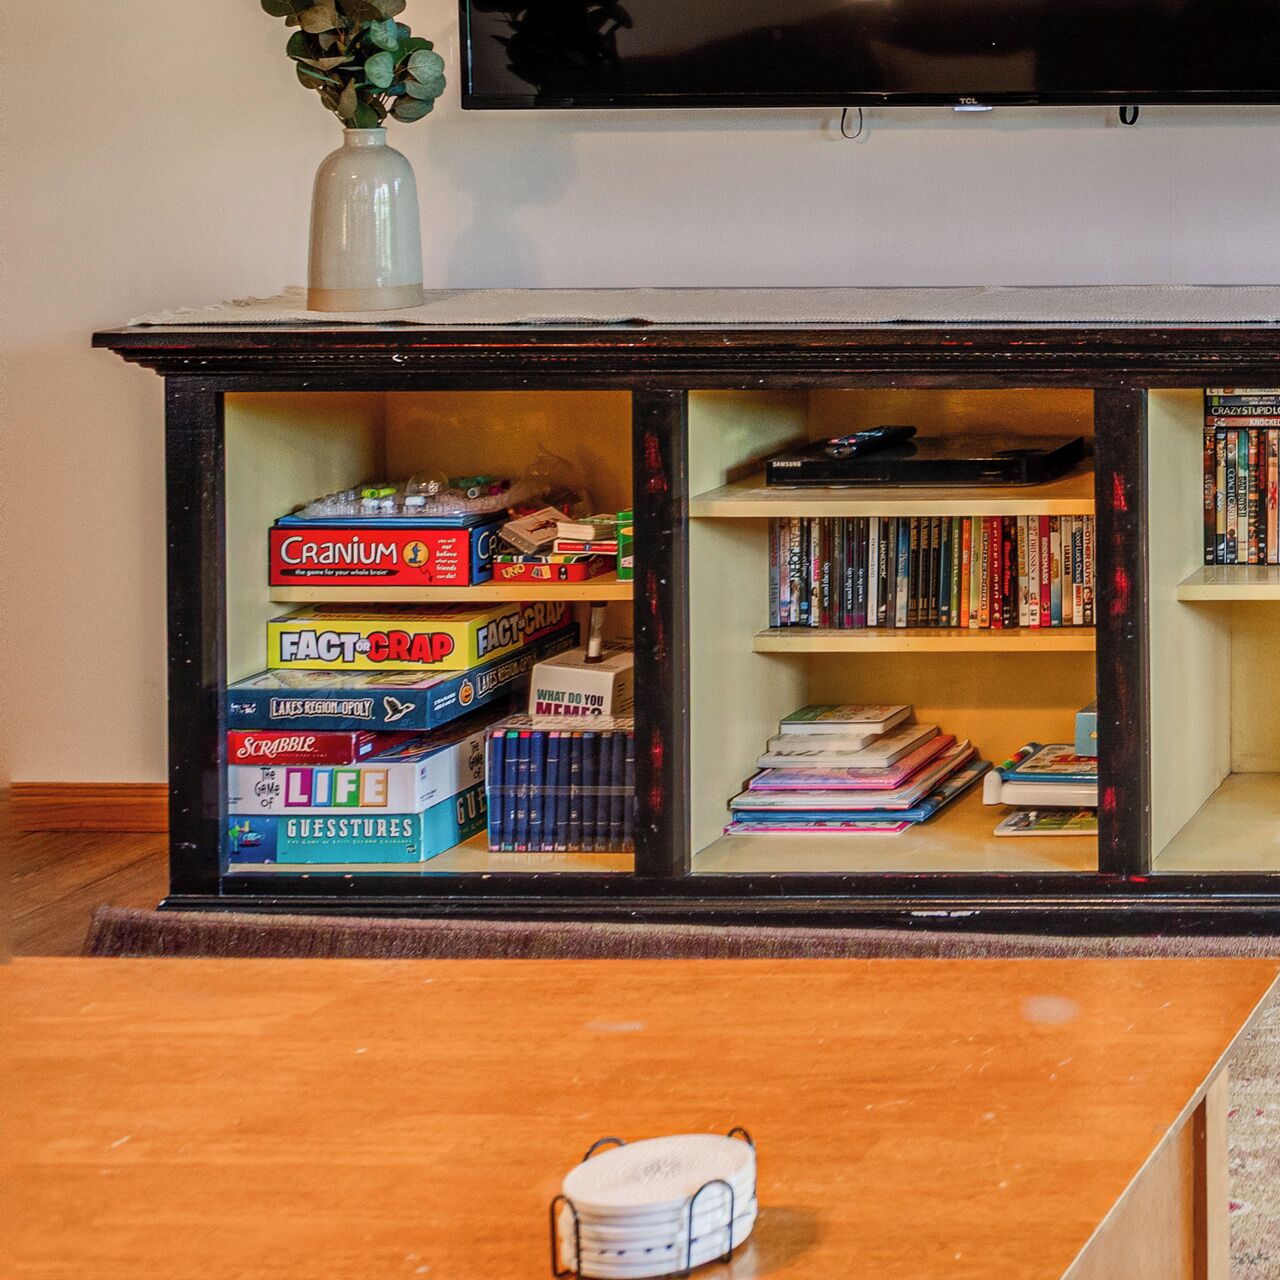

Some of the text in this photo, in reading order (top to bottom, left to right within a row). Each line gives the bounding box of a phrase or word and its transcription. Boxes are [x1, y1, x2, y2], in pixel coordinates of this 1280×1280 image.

[1212, 406, 1243, 415] CRAZY
[1243, 406, 1273, 415] STUPID
[501, 563, 525, 578] UNO
[790, 549, 800, 580] JOHN
[280, 630, 455, 664] FACT OR CRAP
[477, 613, 520, 660] FACT
[536, 688, 604, 706] WHAT DO YOU
[271, 698, 303, 718] LAKES
[236, 736, 316, 758] SCRABBLE
[286, 770, 388, 805] LIFE
[286, 818, 412, 838] GUESSTURES
